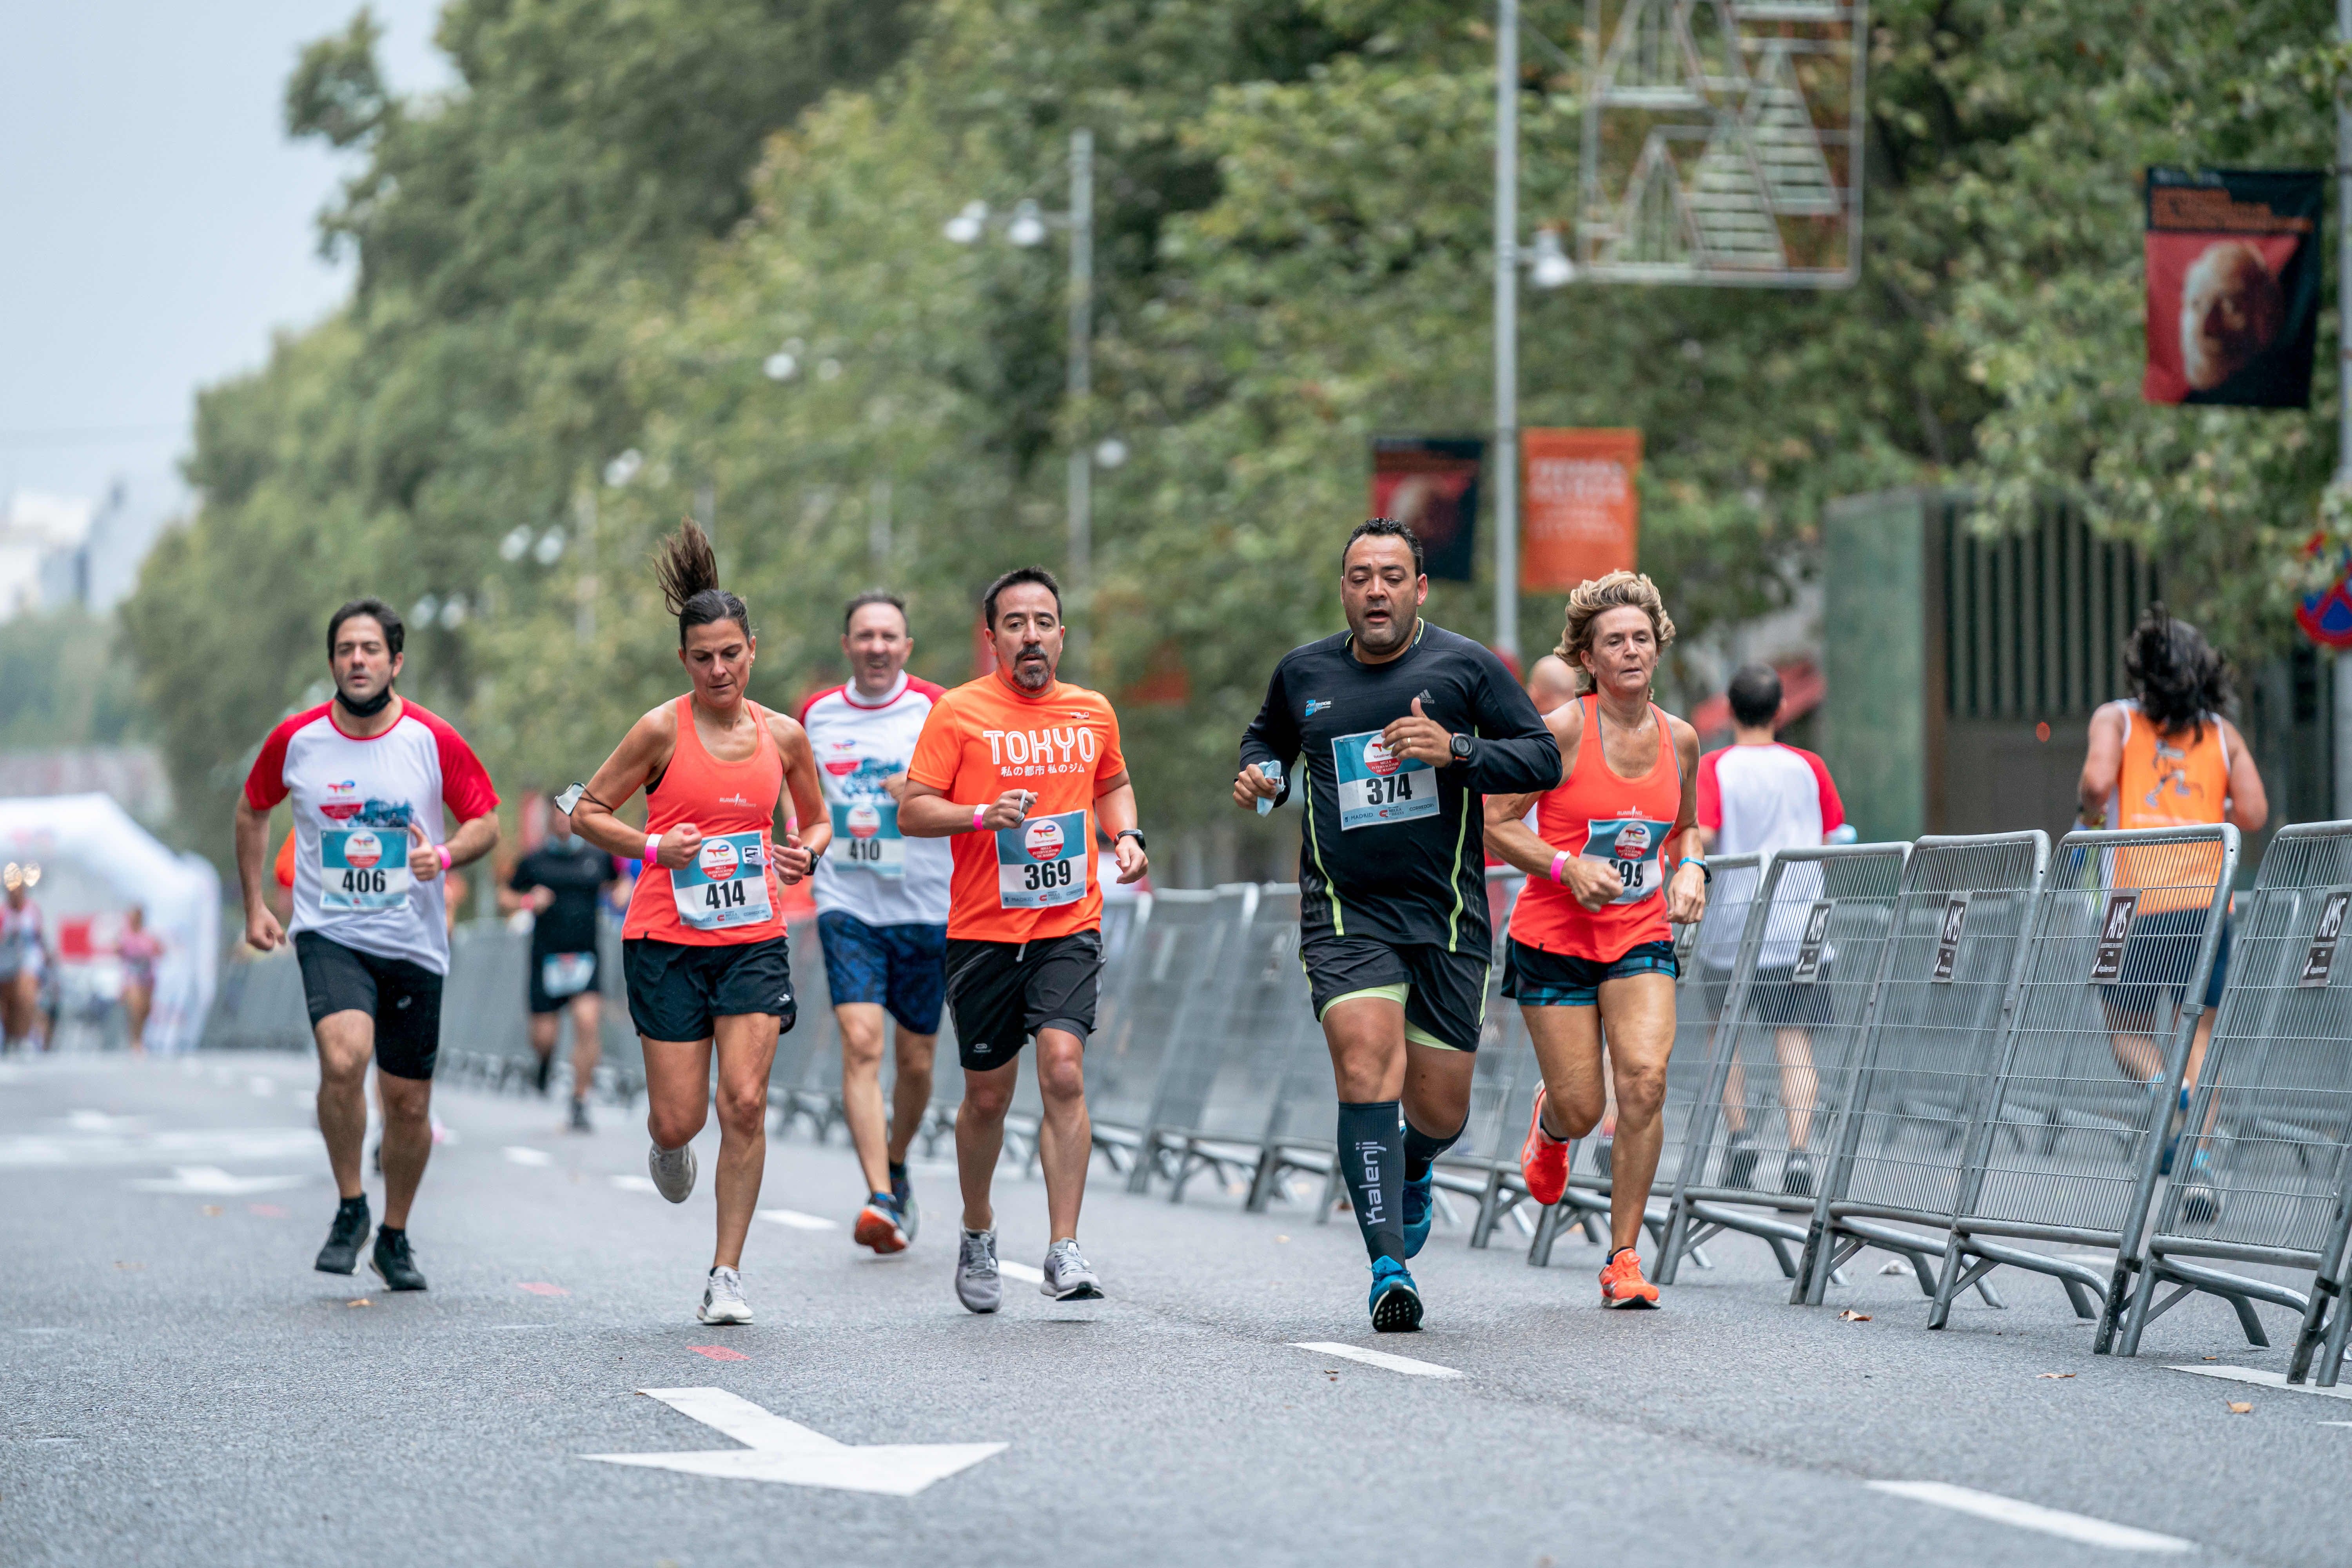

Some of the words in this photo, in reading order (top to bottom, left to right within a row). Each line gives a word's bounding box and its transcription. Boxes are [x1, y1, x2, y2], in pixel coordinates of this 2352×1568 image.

[983, 727, 1095, 765] TOKYO
[1001, 765, 1045, 777] 私の都市
[1047, 762, 1085, 774] 私のジム
[1366, 773, 1412, 805] 374
[849, 838, 880, 860] 410
[342, 868, 386, 893] 406
[1024, 859, 1071, 890] 369
[706, 880, 746, 909] 414
[1807, 908, 1829, 942] AMS
[1944, 906, 1964, 942] AMS
[2106, 902, 2131, 939] AMS
[2318, 897, 2347, 937] AMS
[1356, 1142, 1387, 1225] kalenji
